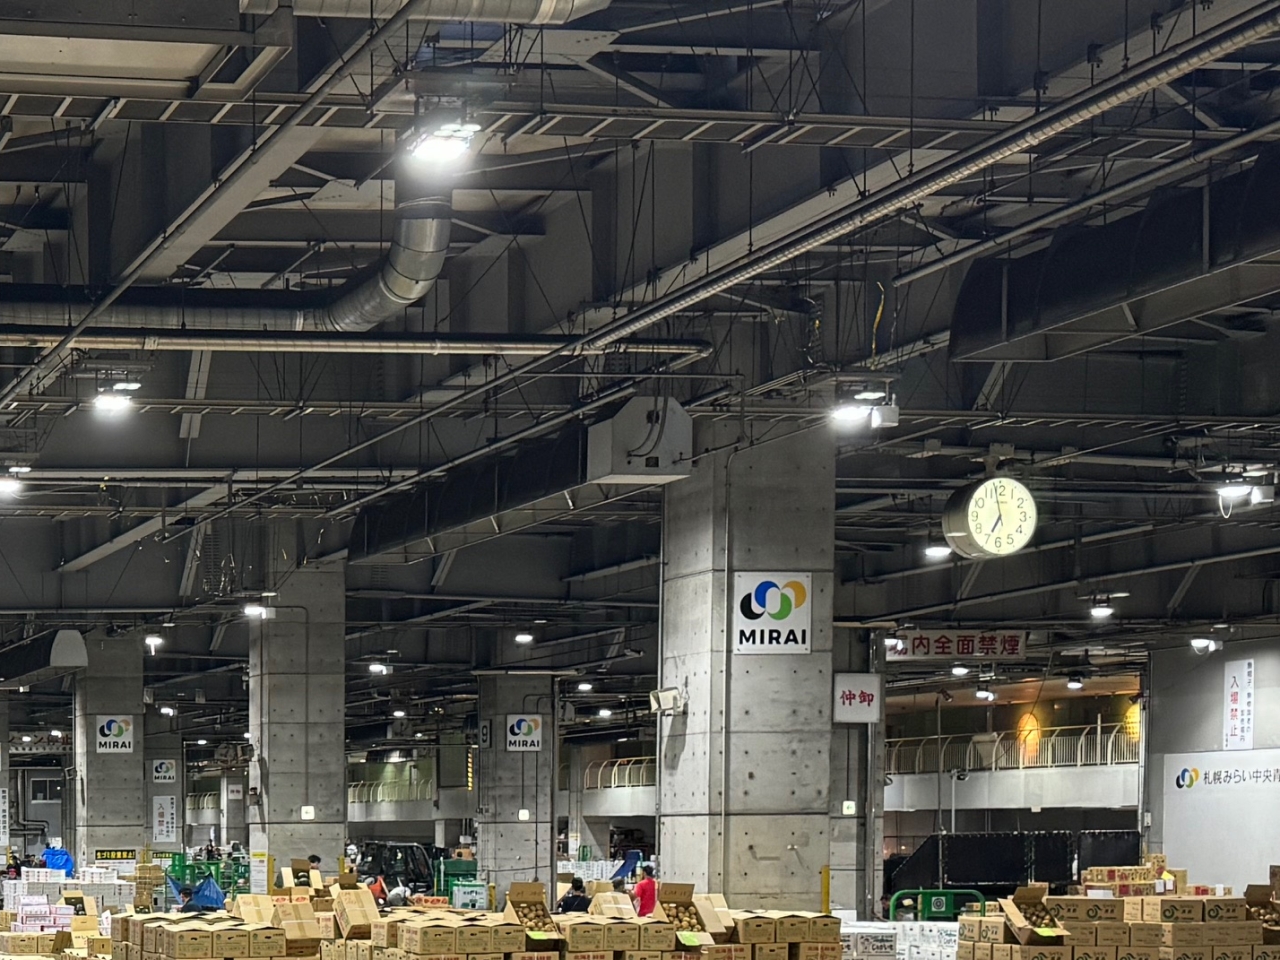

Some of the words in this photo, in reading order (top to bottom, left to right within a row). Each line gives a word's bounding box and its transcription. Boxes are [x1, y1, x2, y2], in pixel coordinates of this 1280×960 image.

[985, 488, 993, 499] 11
[995, 485, 1006, 497] 12
[1010, 489, 1014, 500] 1
[974, 497, 985, 509] 10
[1017, 497, 1024, 509] 2
[971, 511, 979, 522] 9
[1020, 511, 1027, 522] 3
[976, 523, 982, 534] 8
[1016, 524, 1023, 535] 4
[984, 533, 991, 546] 7
[994, 537, 1002, 548] 6
[1006, 534, 1014, 545] 5
[739, 629, 806, 645] MIRAI
[840, 690, 874, 706] 仲卸
[1230, 676, 1239, 737] 入場禁止
[99, 741, 131, 749] MIRAI
[509, 739, 539, 747] MIRAI
